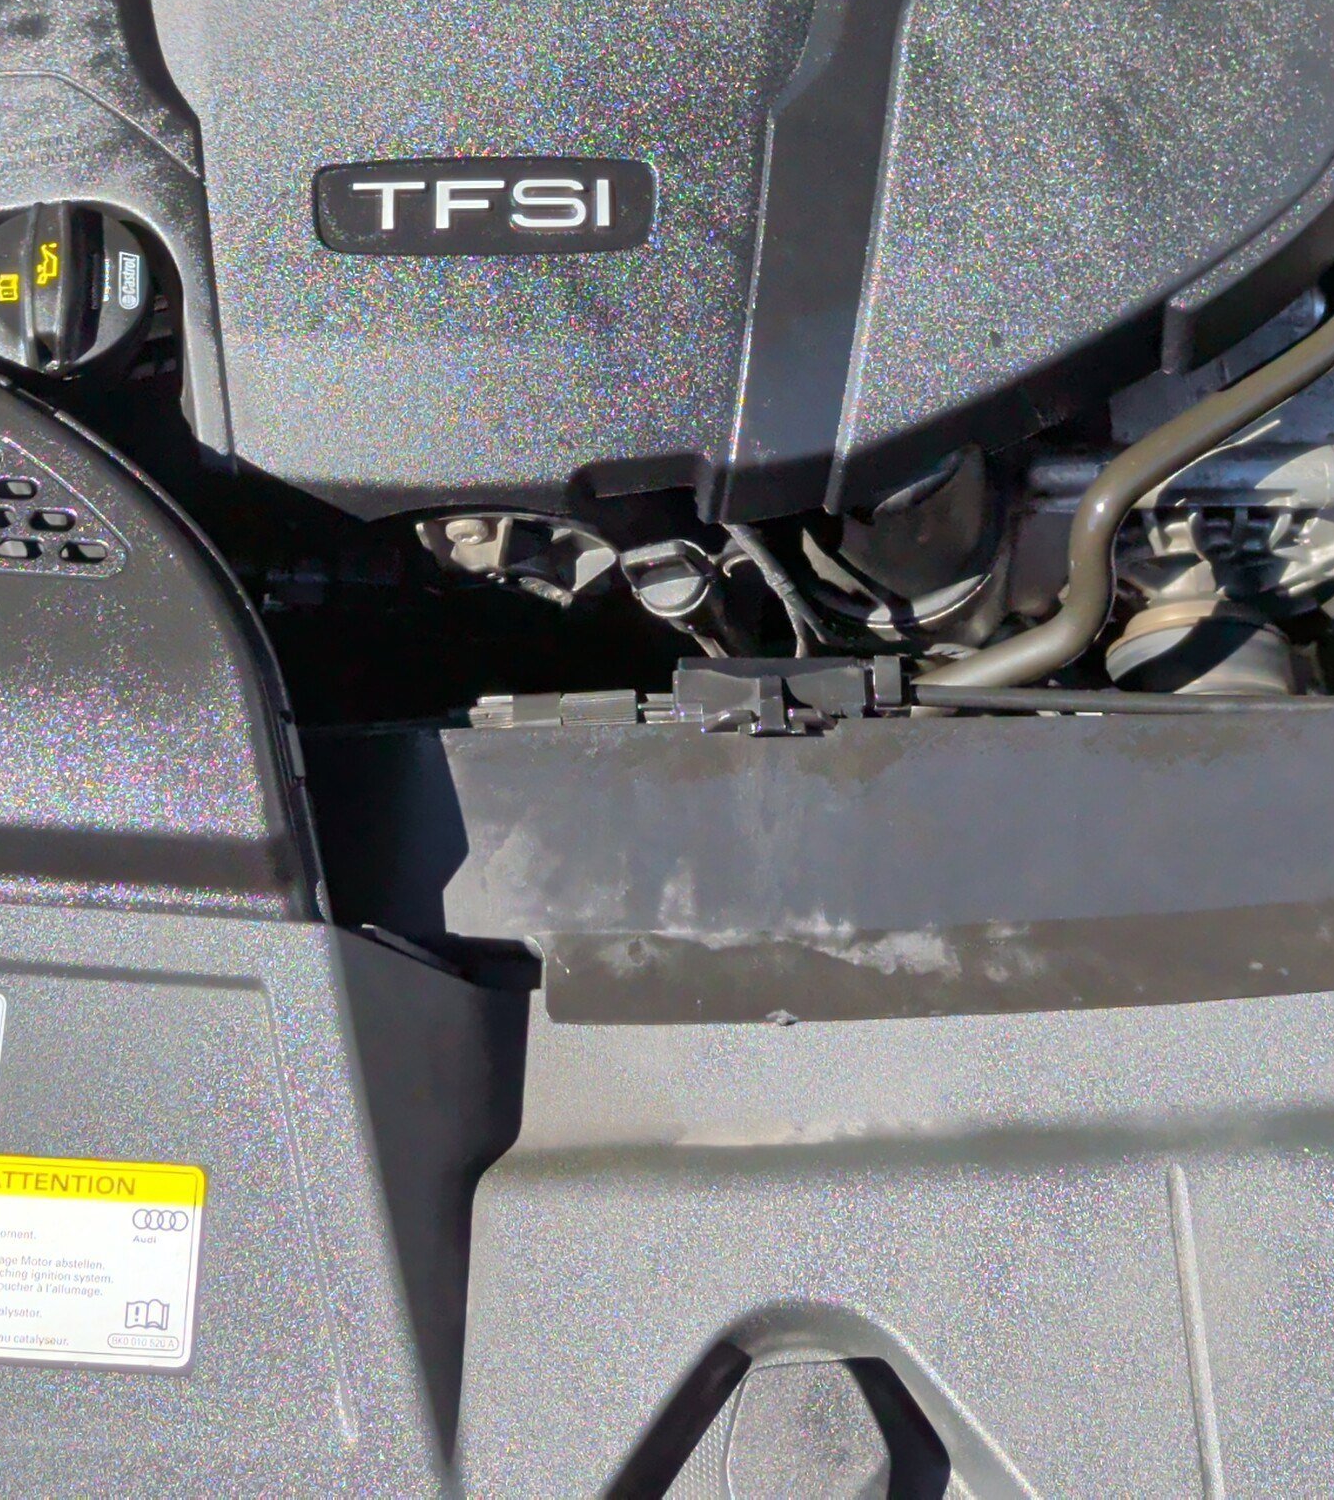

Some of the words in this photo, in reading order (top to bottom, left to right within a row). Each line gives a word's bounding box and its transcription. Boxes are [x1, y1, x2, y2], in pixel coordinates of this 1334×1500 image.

[352, 178, 610, 230] TFSI
[122, 256, 137, 295] Castrol
[133, 1236, 156, 1244] Audi
[21, 1256, 52, 1267] Motor
[55, 1258, 105, 1271] abstellen.
[31, 1271, 71, 1283] ignition
[74, 1275, 113, 1286] system.
[13, 1335, 69, 1348] catalyseur.
